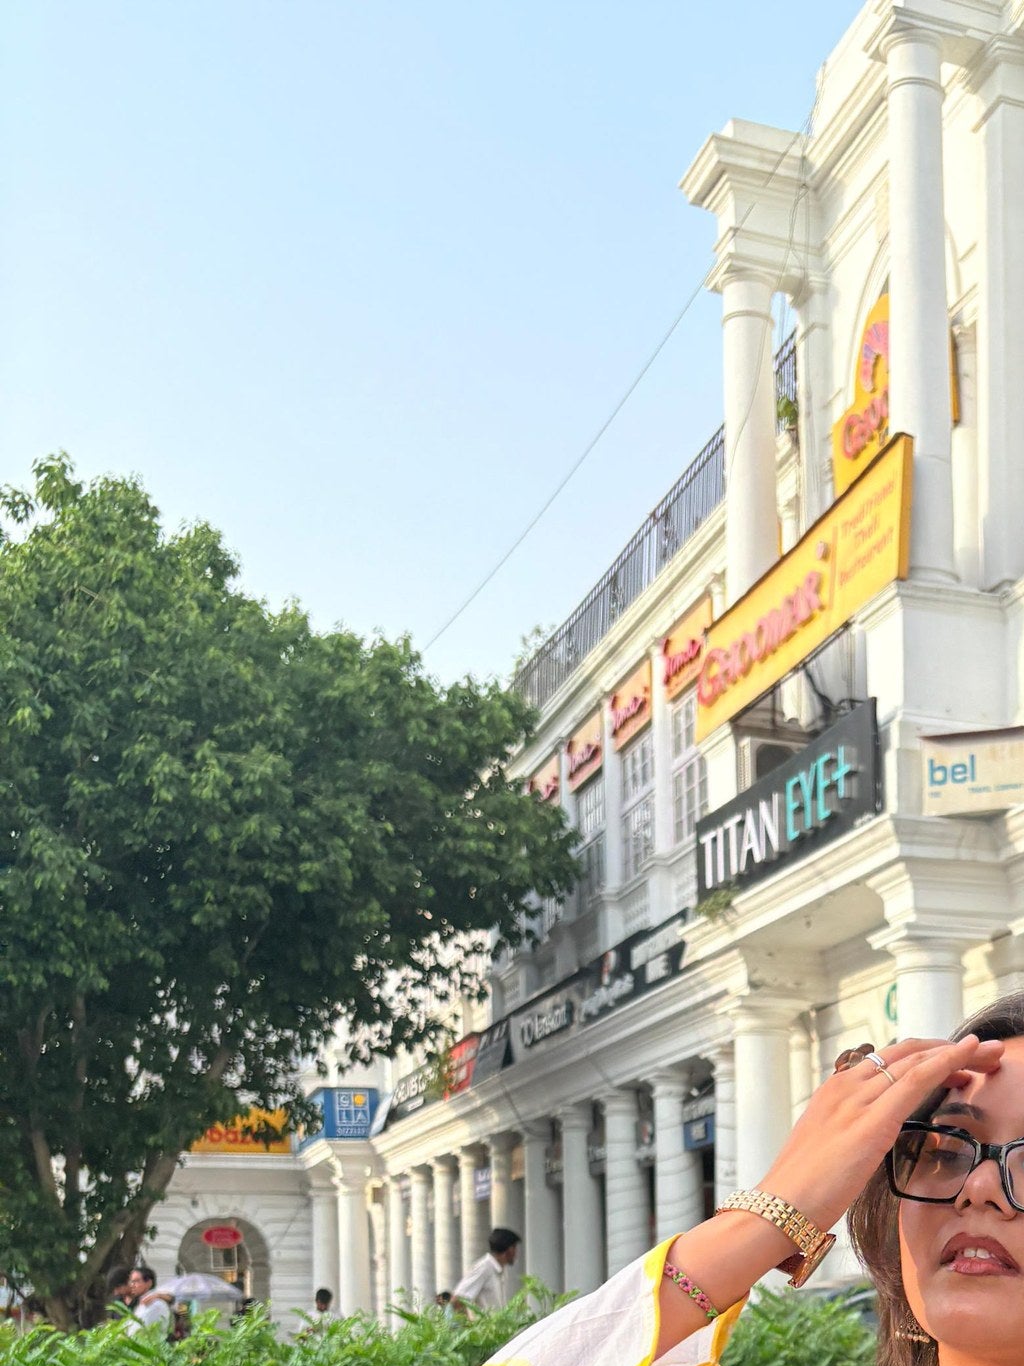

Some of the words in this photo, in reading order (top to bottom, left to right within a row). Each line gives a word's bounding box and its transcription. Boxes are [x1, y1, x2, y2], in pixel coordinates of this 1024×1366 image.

[927, 752, 976, 787] bel
[699, 792, 780, 890] TITAN
[785, 744, 852, 842] EYE+
